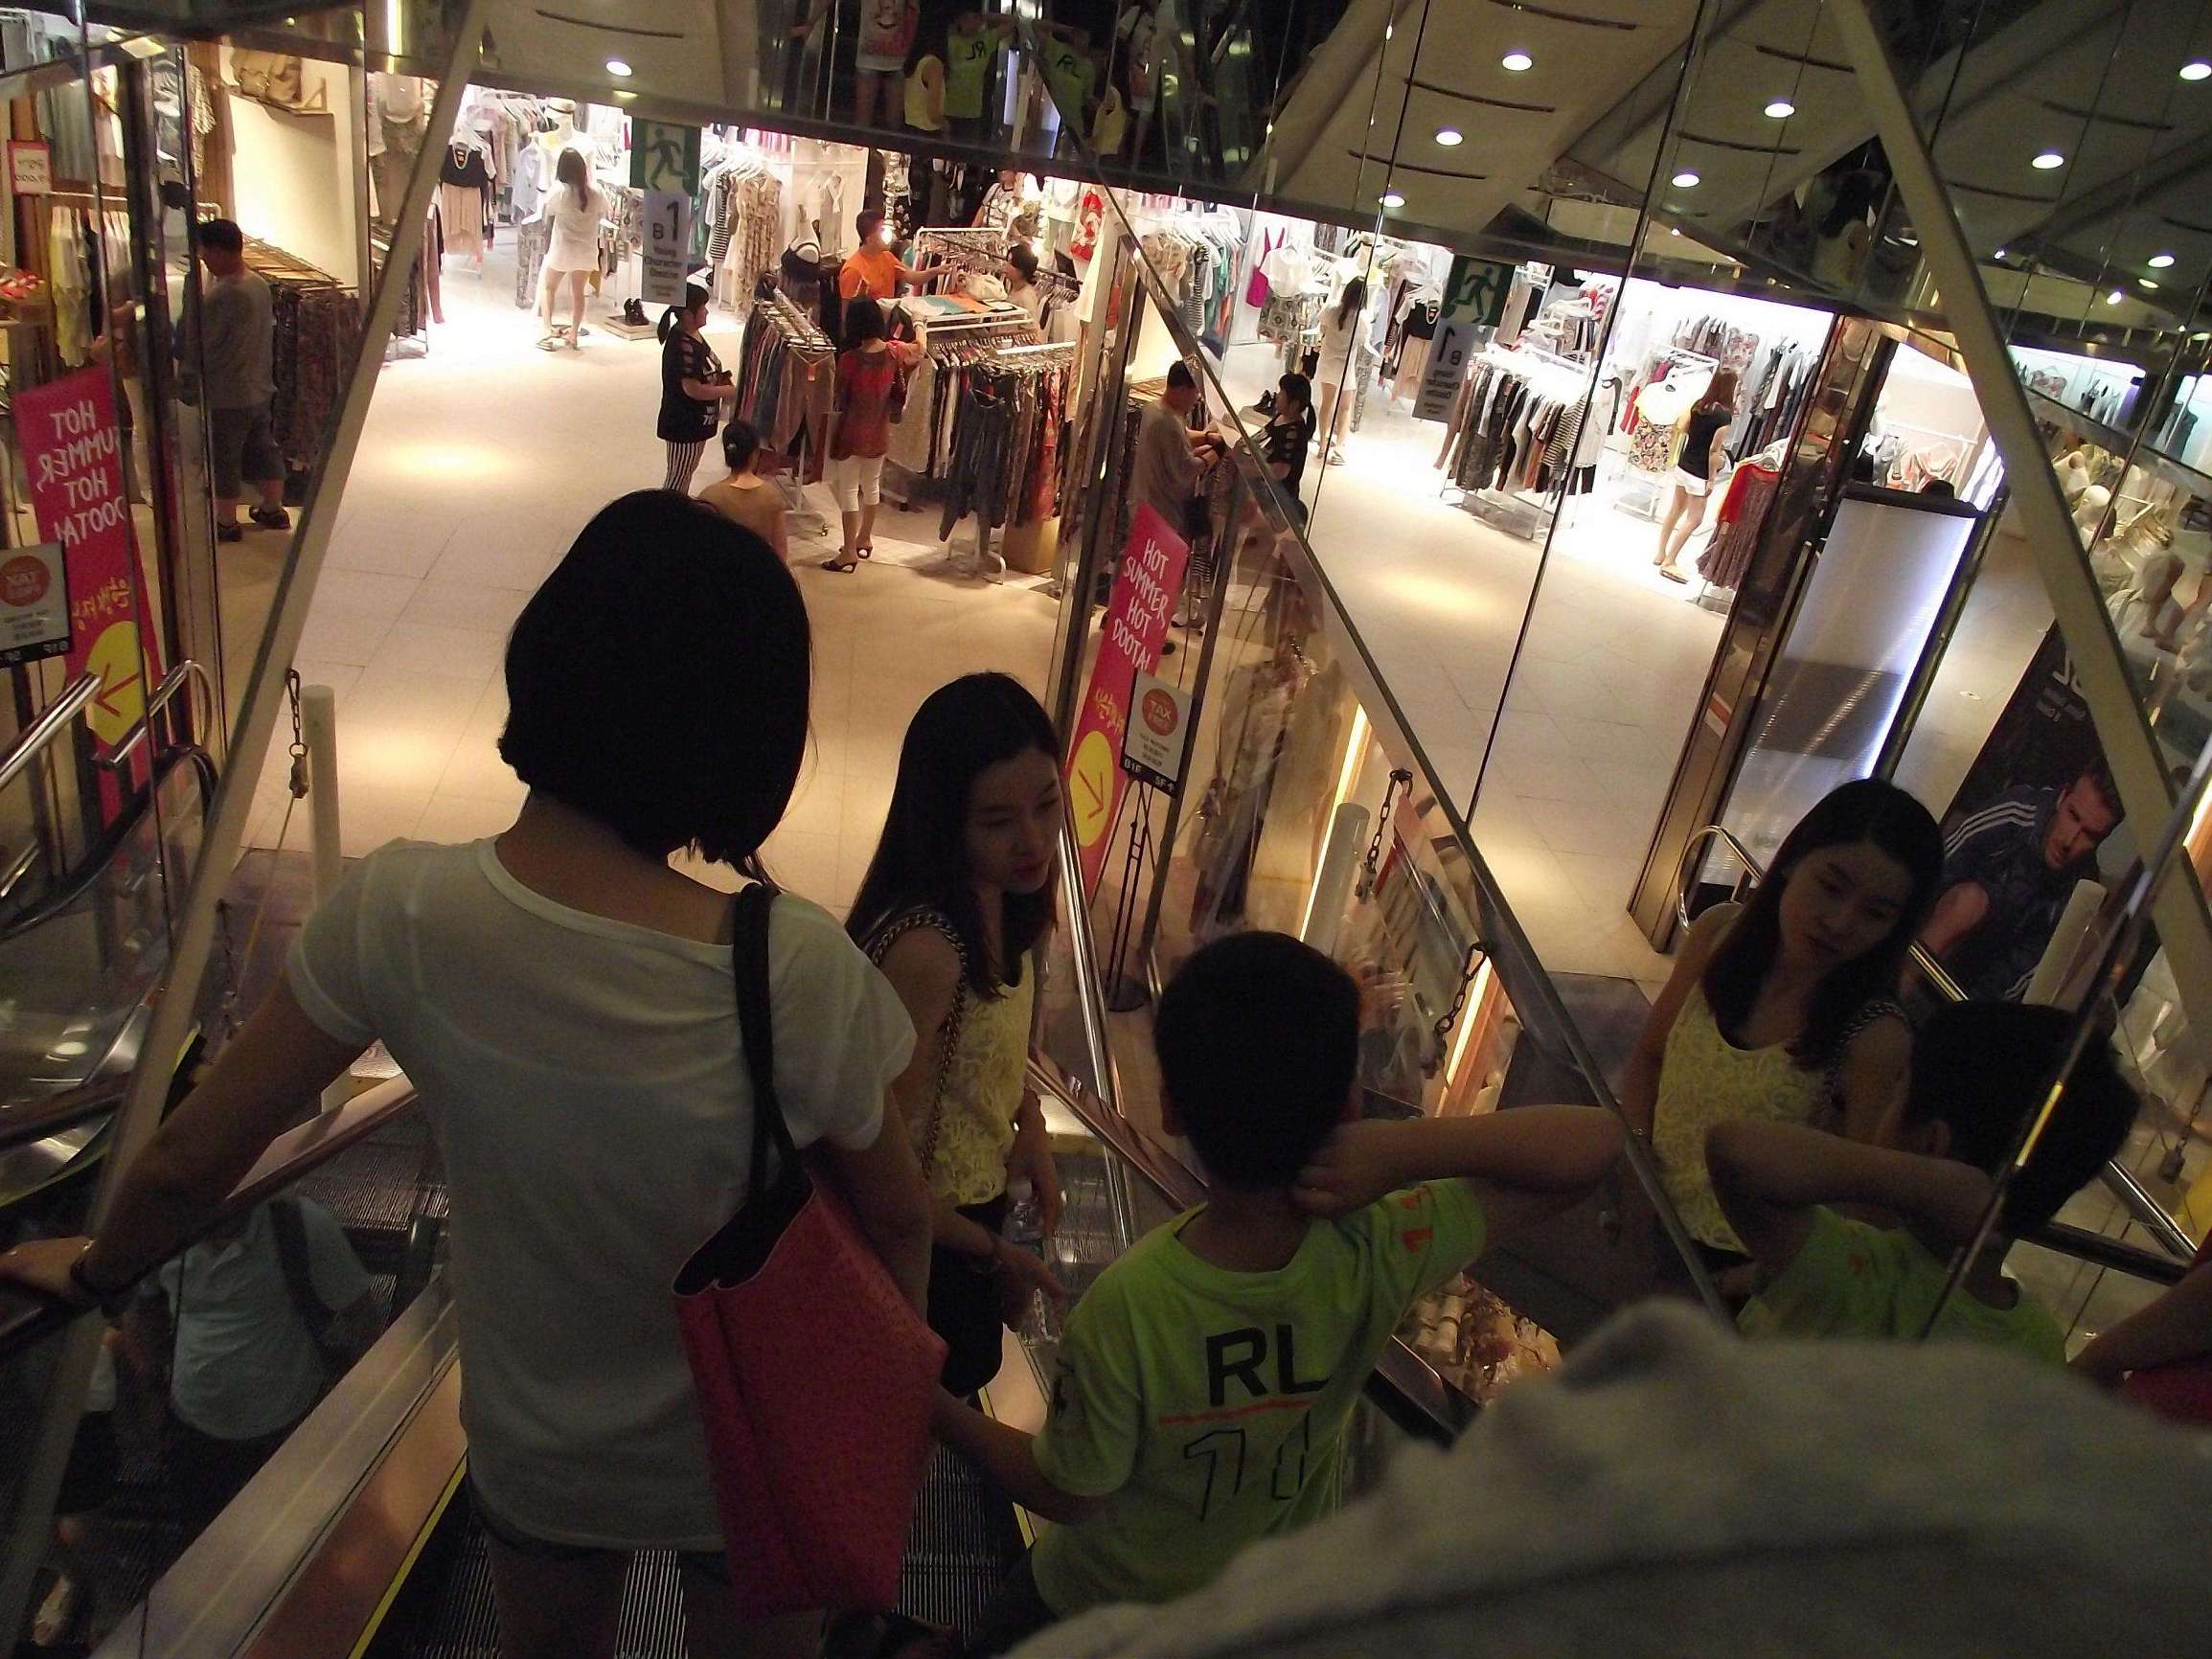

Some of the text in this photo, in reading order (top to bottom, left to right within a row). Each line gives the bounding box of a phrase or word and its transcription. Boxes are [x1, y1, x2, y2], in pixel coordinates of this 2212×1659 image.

[1143, 536, 1170, 580] HOT
[1126, 596, 1152, 638] HOT
[1150, 699, 1172, 721] TAX
[1205, 1324, 1333, 1408] RL
